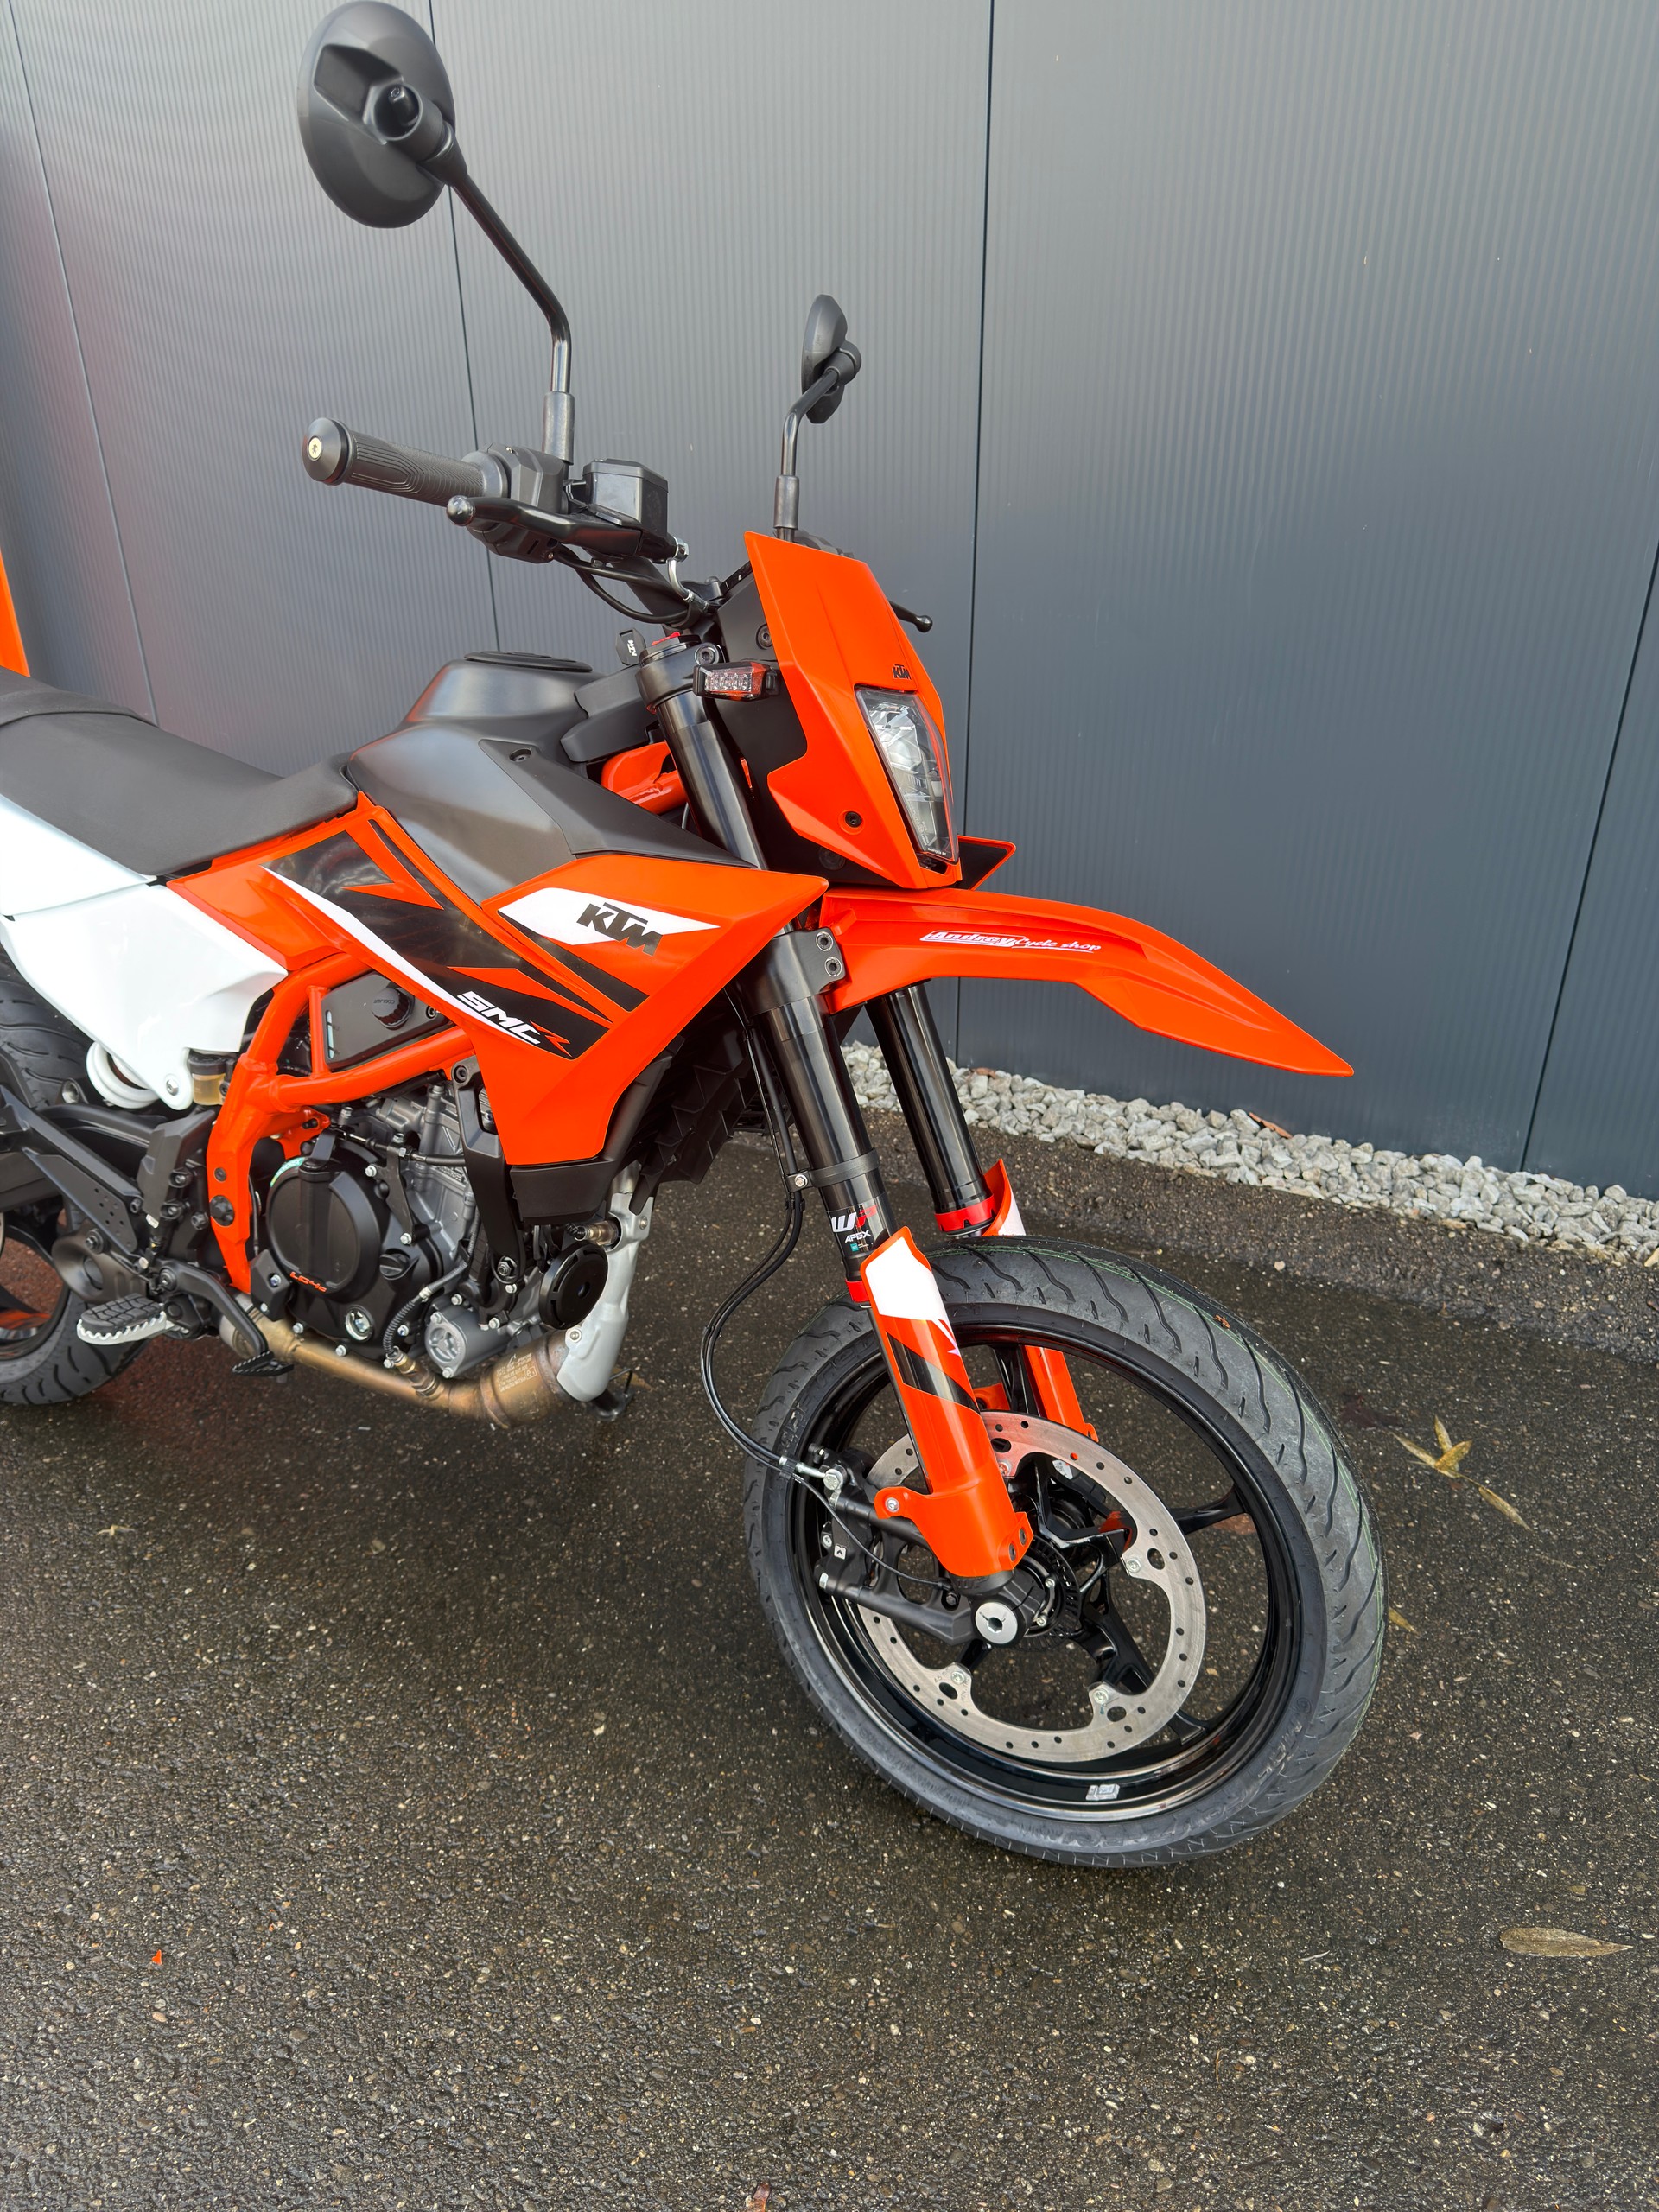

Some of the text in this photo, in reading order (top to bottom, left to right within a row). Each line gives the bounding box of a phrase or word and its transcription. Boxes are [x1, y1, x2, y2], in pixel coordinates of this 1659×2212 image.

[892, 664, 912, 681] KTM
[576, 902, 664, 956] KTM
[1061, 941, 1102, 951] shop
[831, 1205, 877, 1233] WP
[845, 1229, 872, 1243] APEX
